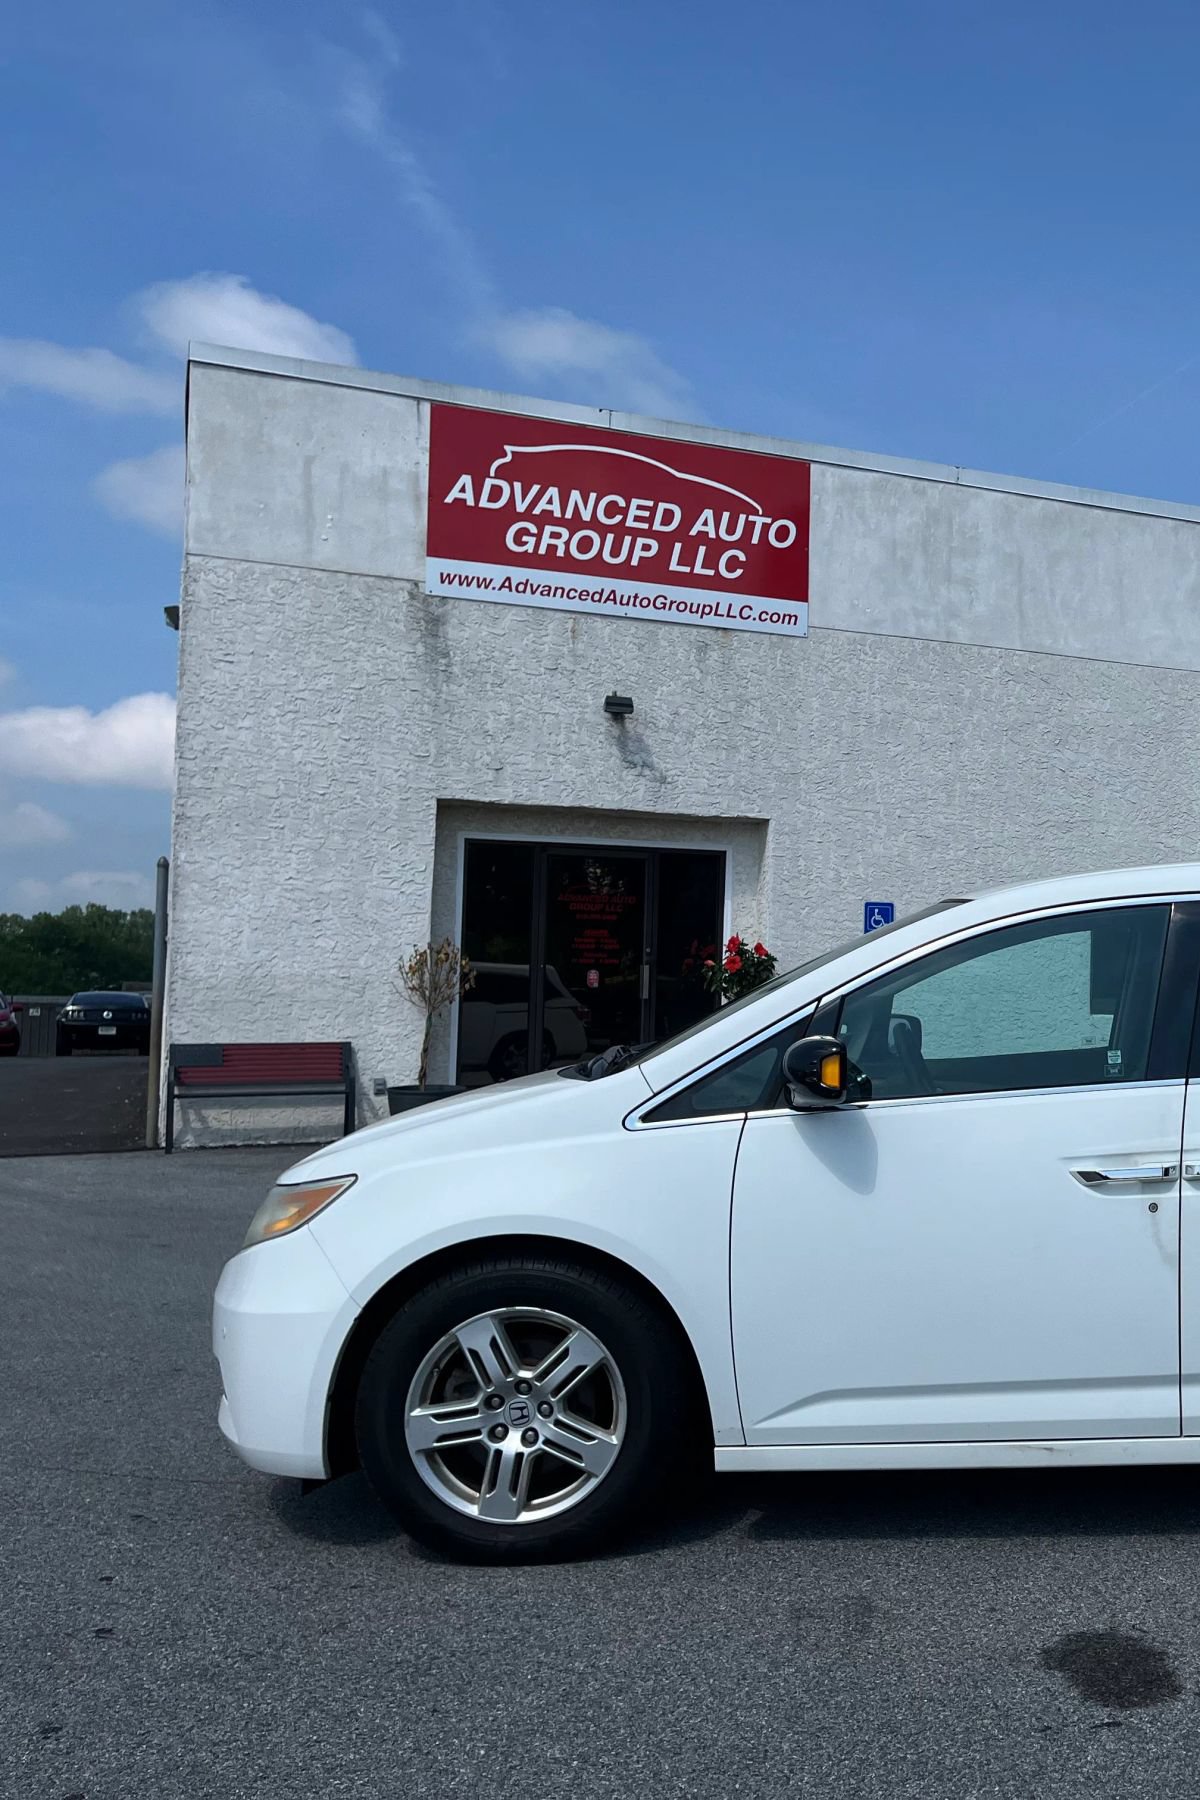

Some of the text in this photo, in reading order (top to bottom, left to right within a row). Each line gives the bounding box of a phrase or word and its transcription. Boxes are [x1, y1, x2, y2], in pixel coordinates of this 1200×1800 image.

[444, 475, 797, 549] ADVANCED AUTO
[504, 521, 747, 580] GROUP LLC
[438, 571, 799, 627] www.AdvancedAutoGroupLLC.com
